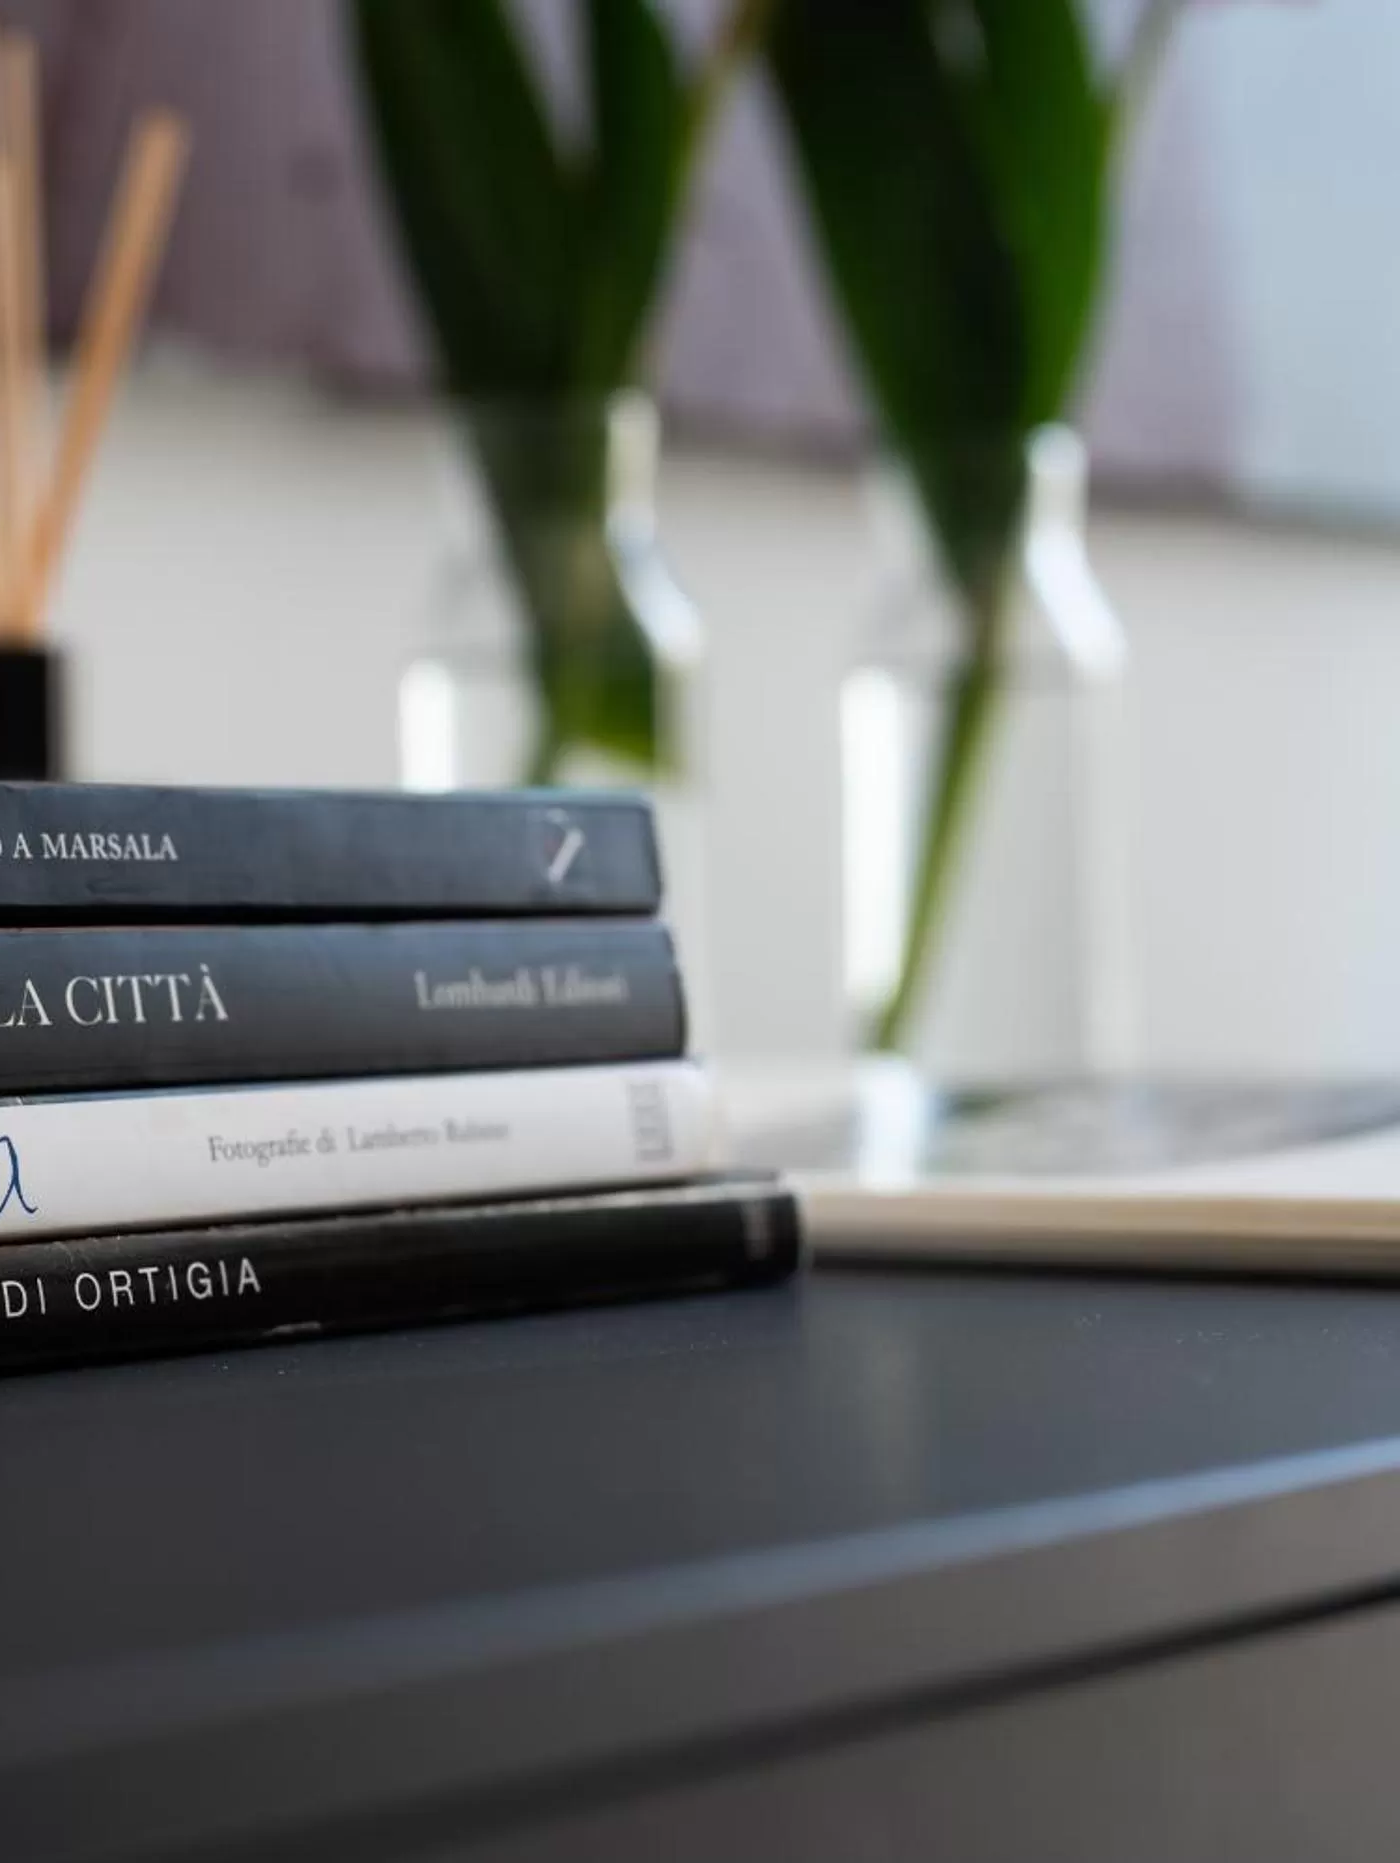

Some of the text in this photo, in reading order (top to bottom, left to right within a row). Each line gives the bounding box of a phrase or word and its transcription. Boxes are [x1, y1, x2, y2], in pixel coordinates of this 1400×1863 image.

[12, 832, 33, 860] A
[41, 833, 179, 862] MARSALA
[65, 963, 230, 1027] CITTÀ
[207, 1128, 311, 1169] Fotografie
[315, 1127, 338, 1155] di
[2, 1279, 48, 1318] DI
[75, 1257, 263, 1311] ORTIGIA
